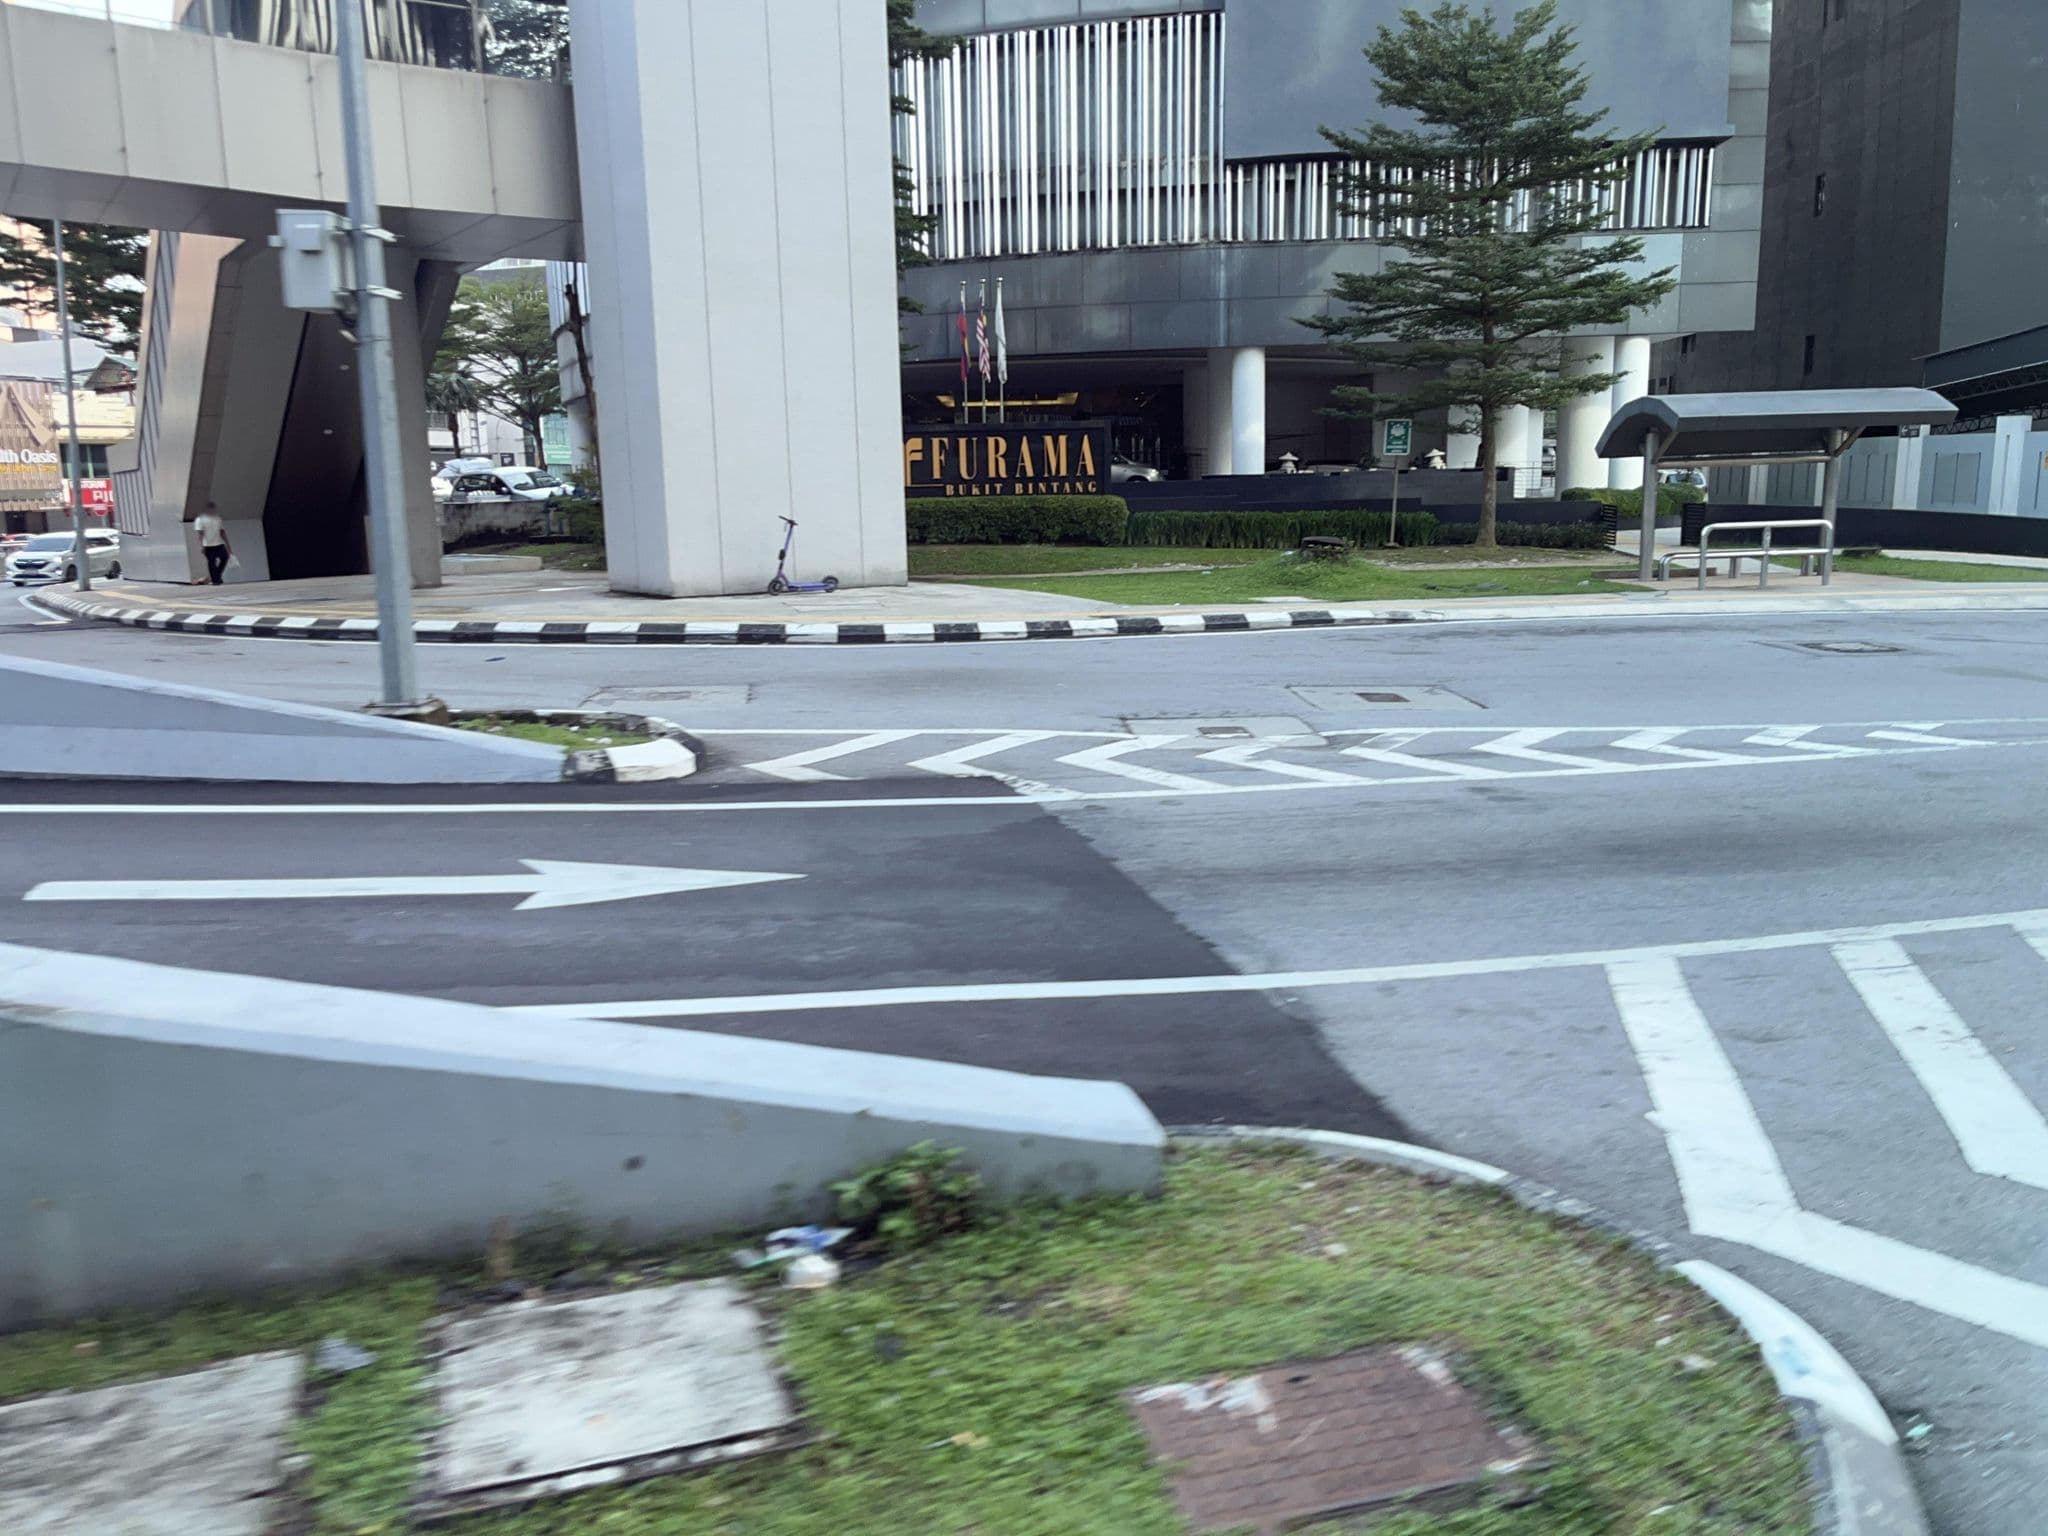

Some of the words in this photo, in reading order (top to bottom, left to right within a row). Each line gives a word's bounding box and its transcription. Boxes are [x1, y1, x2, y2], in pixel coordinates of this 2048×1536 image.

[20, 448, 58, 464] Oasis
[930, 434, 1095, 480] FURAMA
[946, 482, 1003, 497] BUKIT
[1015, 481, 1097, 495] BINTANG
